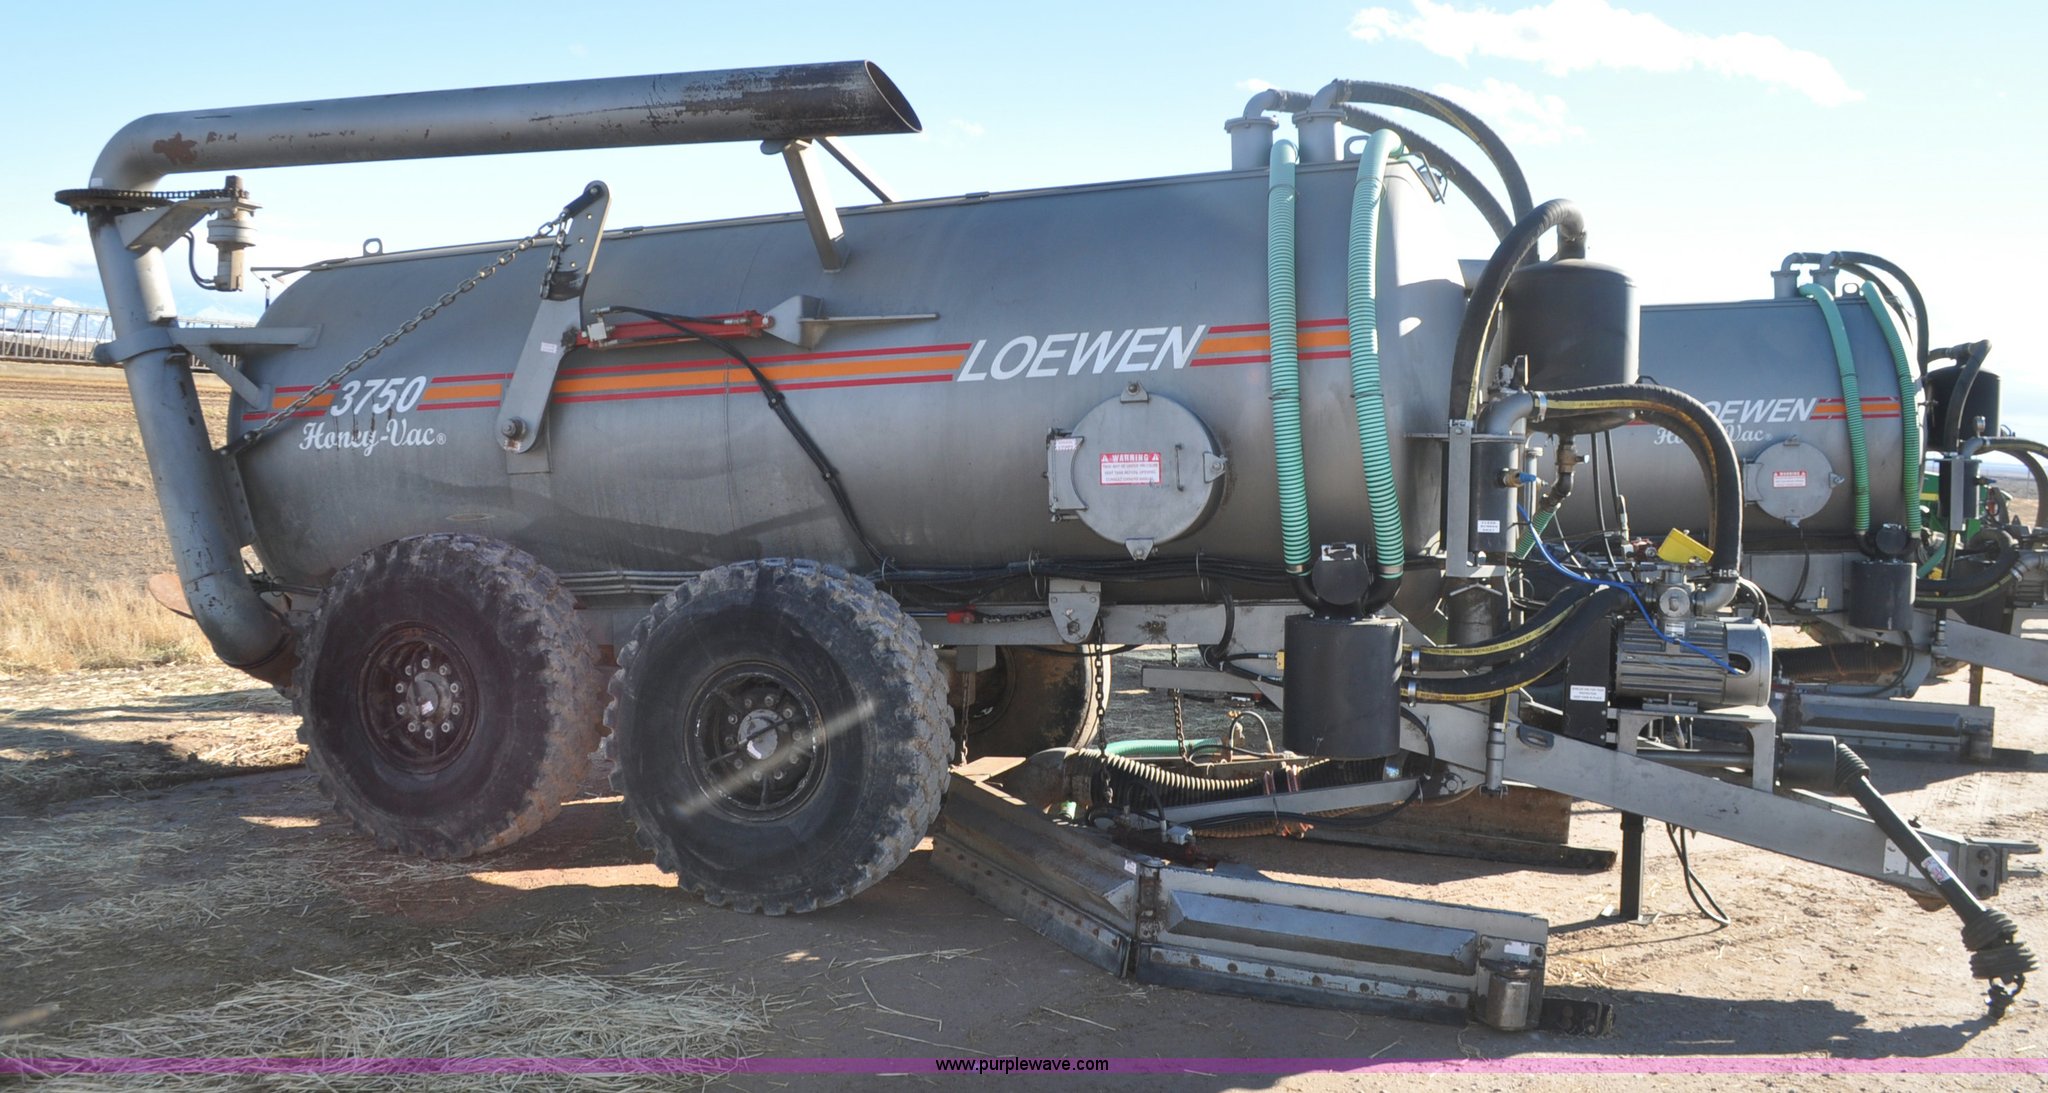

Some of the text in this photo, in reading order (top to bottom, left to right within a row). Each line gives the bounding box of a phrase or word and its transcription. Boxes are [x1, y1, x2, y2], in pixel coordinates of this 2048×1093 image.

[957, 324, 1206, 382] LOEWEN
[330, 375, 427, 417] 3750
[1703, 397, 1817, 425] OEWEN
[1111, 453, 1149, 463] WARNING
